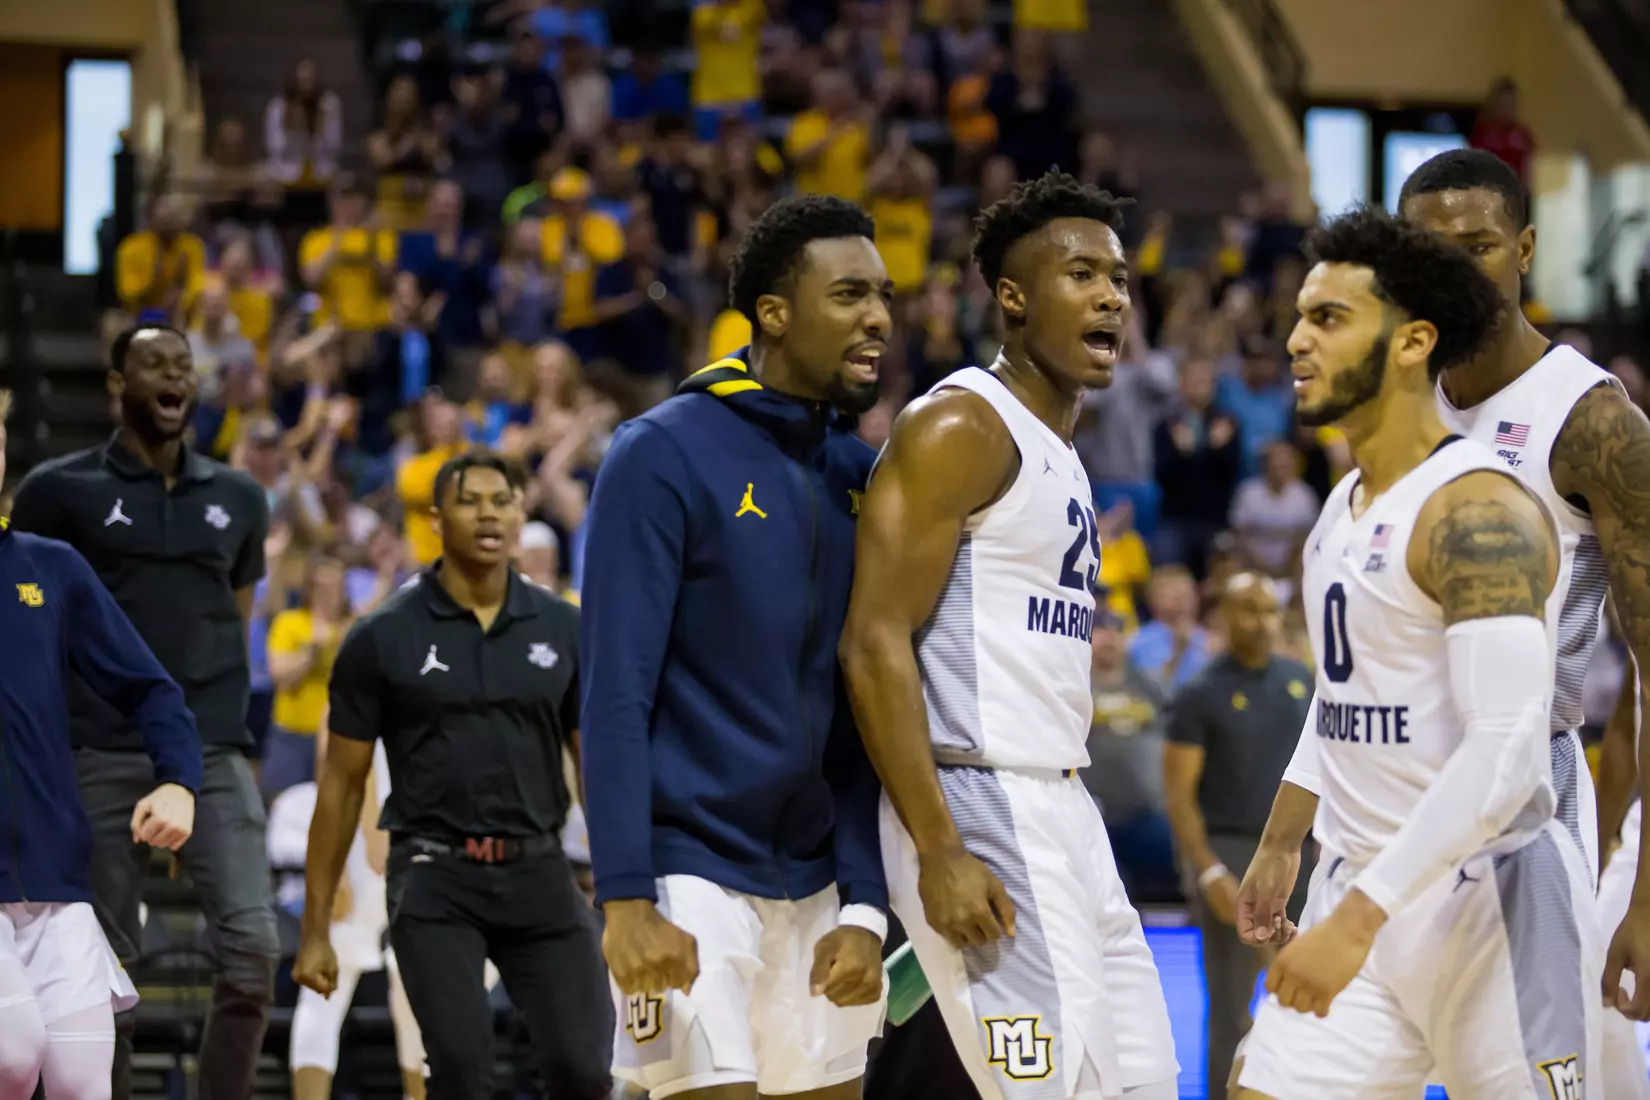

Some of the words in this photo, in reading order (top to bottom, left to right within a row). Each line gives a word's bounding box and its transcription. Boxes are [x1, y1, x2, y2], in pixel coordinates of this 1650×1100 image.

[1059, 497, 1100, 594] 25
[1027, 596, 1094, 645] MARQU
[1324, 582, 1354, 683] 0
[980, 1014, 1054, 1082] MU
